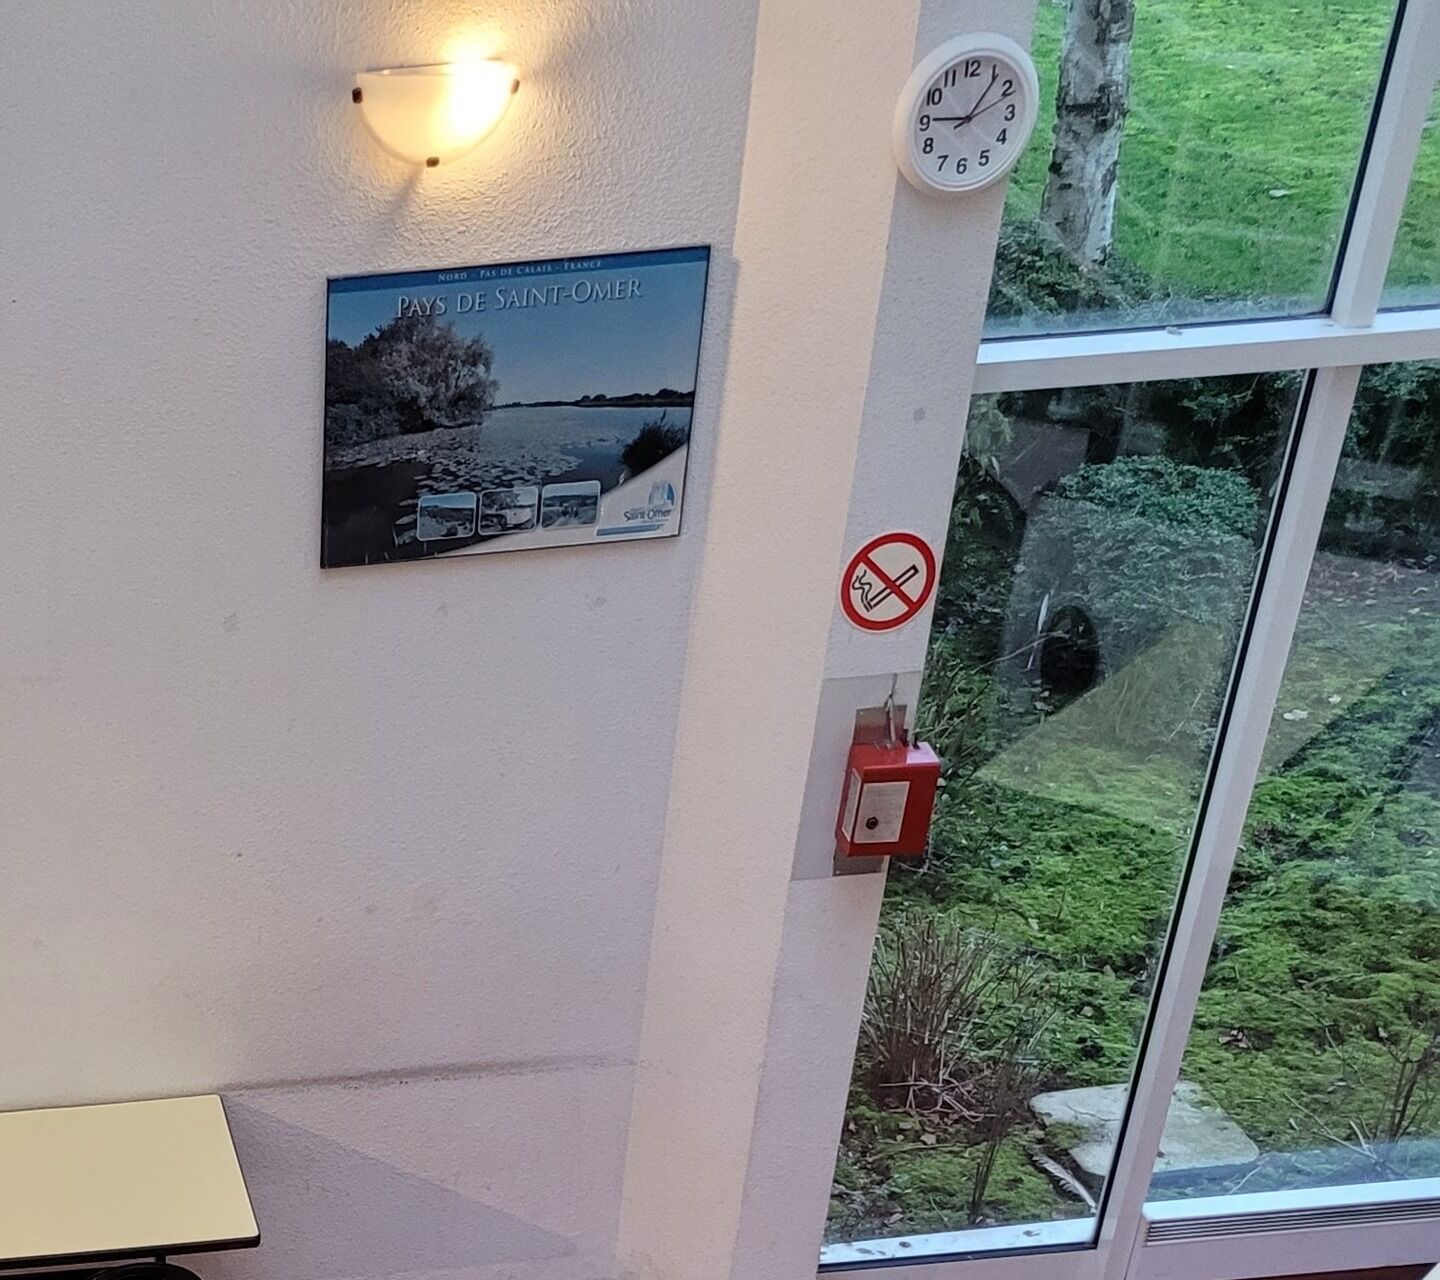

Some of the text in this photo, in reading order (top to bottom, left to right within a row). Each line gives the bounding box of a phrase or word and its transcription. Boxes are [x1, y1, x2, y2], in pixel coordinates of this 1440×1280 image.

[964, 60, 981, 78] 12
[992, 64, 998, 80] 1
[944, 70, 957, 88] 11
[926, 88, 943, 106] 10
[1001, 79, 1014, 98] 2
[1004, 104, 1016, 121] 3
[919, 114, 931, 131] 9
[996, 128, 1007, 145] 4
[922, 137, 934, 154] 8
[937, 155, 949, 172] 7
[956, 158, 968, 174] 6
[978, 149, 990, 166] 5
[438, 272, 468, 282] NORD
[396, 279, 643, 318] PAYS DE SAINT-OMER
